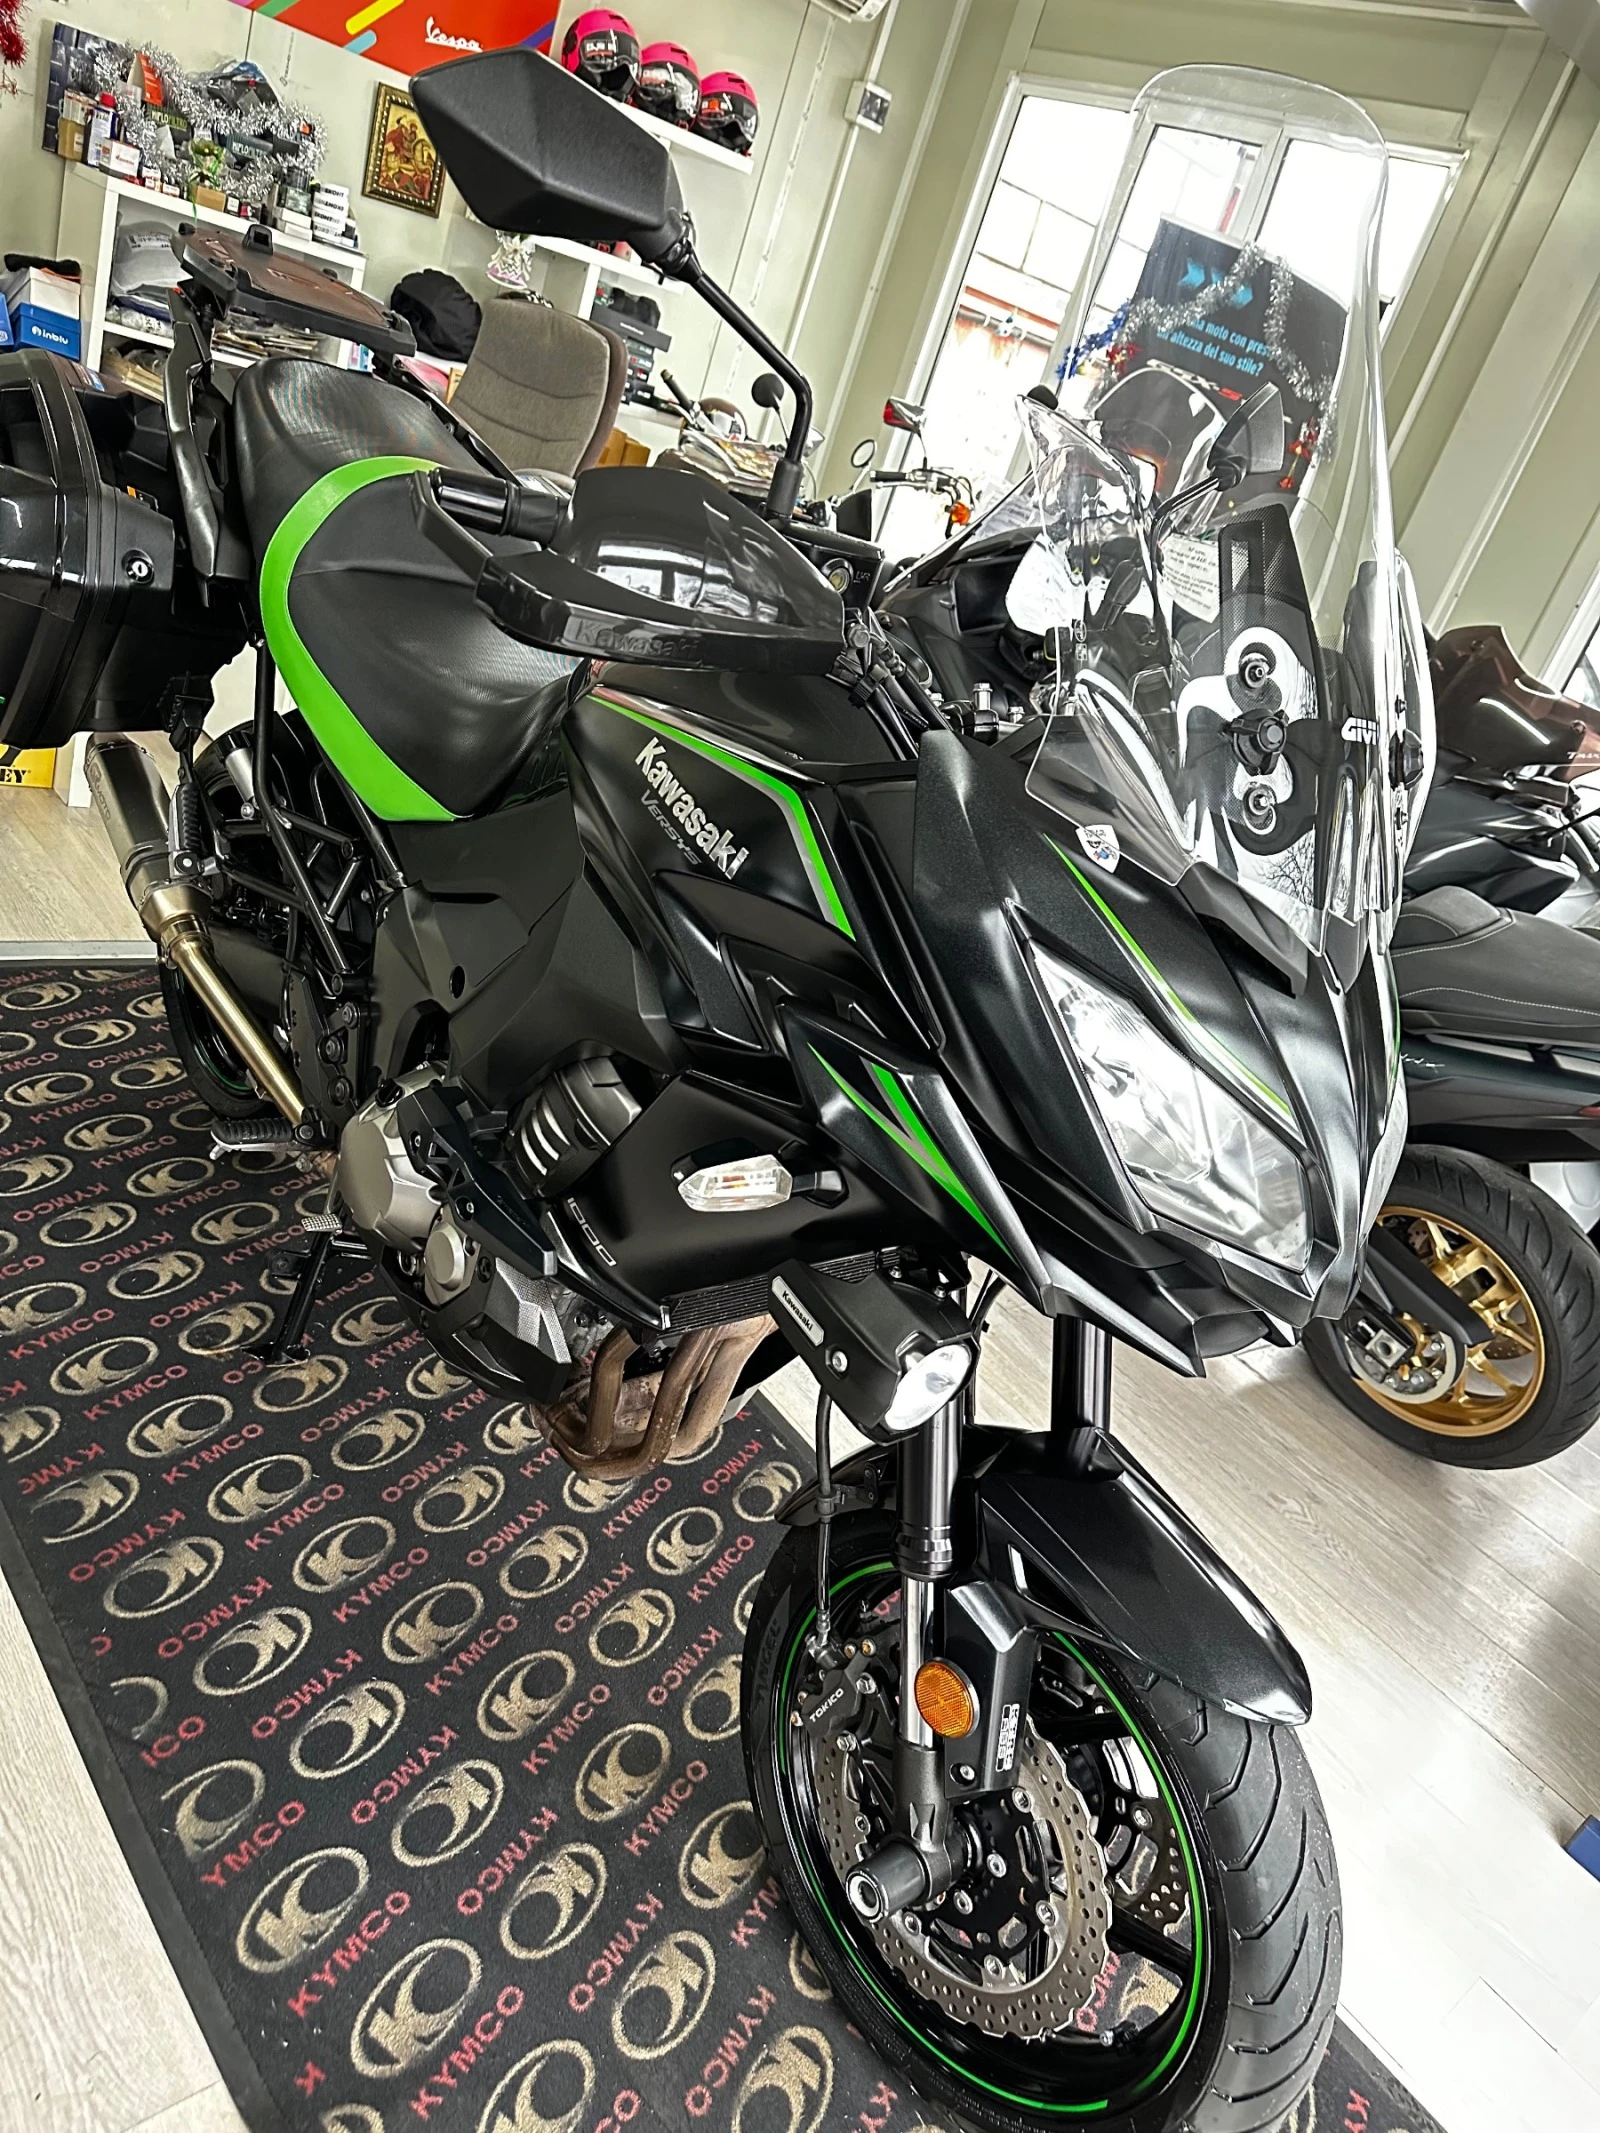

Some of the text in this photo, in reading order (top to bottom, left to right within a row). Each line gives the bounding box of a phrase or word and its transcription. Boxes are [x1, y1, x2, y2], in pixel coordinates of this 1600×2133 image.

[425, 16, 484, 53] Vespa
[42, 328, 69, 346] inblu
[1203, 342, 1218, 360] del
[1218, 350, 1235, 367] suo
[1236, 357, 1264, 377] stile?
[1205, 321, 1229, 341] moto
[1229, 331, 1247, 348] con
[634, 736, 751, 880] Kawasaki
[640, 788, 703, 867] VERSYS
[30, 1093, 118, 1125] KYMCO
[146, 1089, 197, 1109] MCO
[91, 1135, 178, 1169] KYMCO
[13, 1182, 109, 1222] KYMCO
[154, 1179, 241, 1217] KYMCO
[79, 1231, 174, 1274] KYMCO
[222, 1224, 305, 1266] KYMCO
[8, 1308, 116, 1361] KYMCO
[149, 1281, 243, 1328] KYMCO
[781, 1289, 814, 1333] Kawasaki
[365, 1329, 425, 1368] KYMC
[82, 1364, 188, 1422] KYMCO
[300, 1387, 390, 1443] KYMCO
[441, 1388, 488, 1422] KYM
[18, 1442, 106, 1495] KYMC
[163, 1424, 263, 1485] KYMCO
[382, 1441, 467, 1503] KYMCO
[701, 1438, 763, 1494] KYMCO
[246, 1484, 344, 1551] KYMCO
[466, 1500, 548, 1566] KYMCO
[603, 1477, 673, 1538] KYMCO
[68, 1509, 186, 1582] KYMCO
[687, 1534, 756, 1602] KYMCO
[333, 1548, 430, 1623] KYMCO
[555, 1563, 633, 1632] KYMCO
[157, 1576, 273, 1659] KYMCO
[425, 1615, 518, 1695] KYMCO
[647, 1626, 721, 1705] KYMCO
[251, 1649, 362, 1740] KYMCO
[809, 1687, 845, 1723] TOKICO
[522, 1684, 610, 1774] KYMCO
[351, 1726, 458, 1825] KYMCO
[624, 1760, 707, 1855] KYMCO
[201, 1799, 306, 1888] YMCO
[456, 1807, 558, 1916] KYMCO
[730, 1877, 781, 1948] KYM
[287, 1890, 411, 2018] KYMCO
[568, 1892, 664, 2013] KYMCO
[409, 1985, 525, 2120] KYMCO
[684, 1986, 776, 2117] KYMCO
